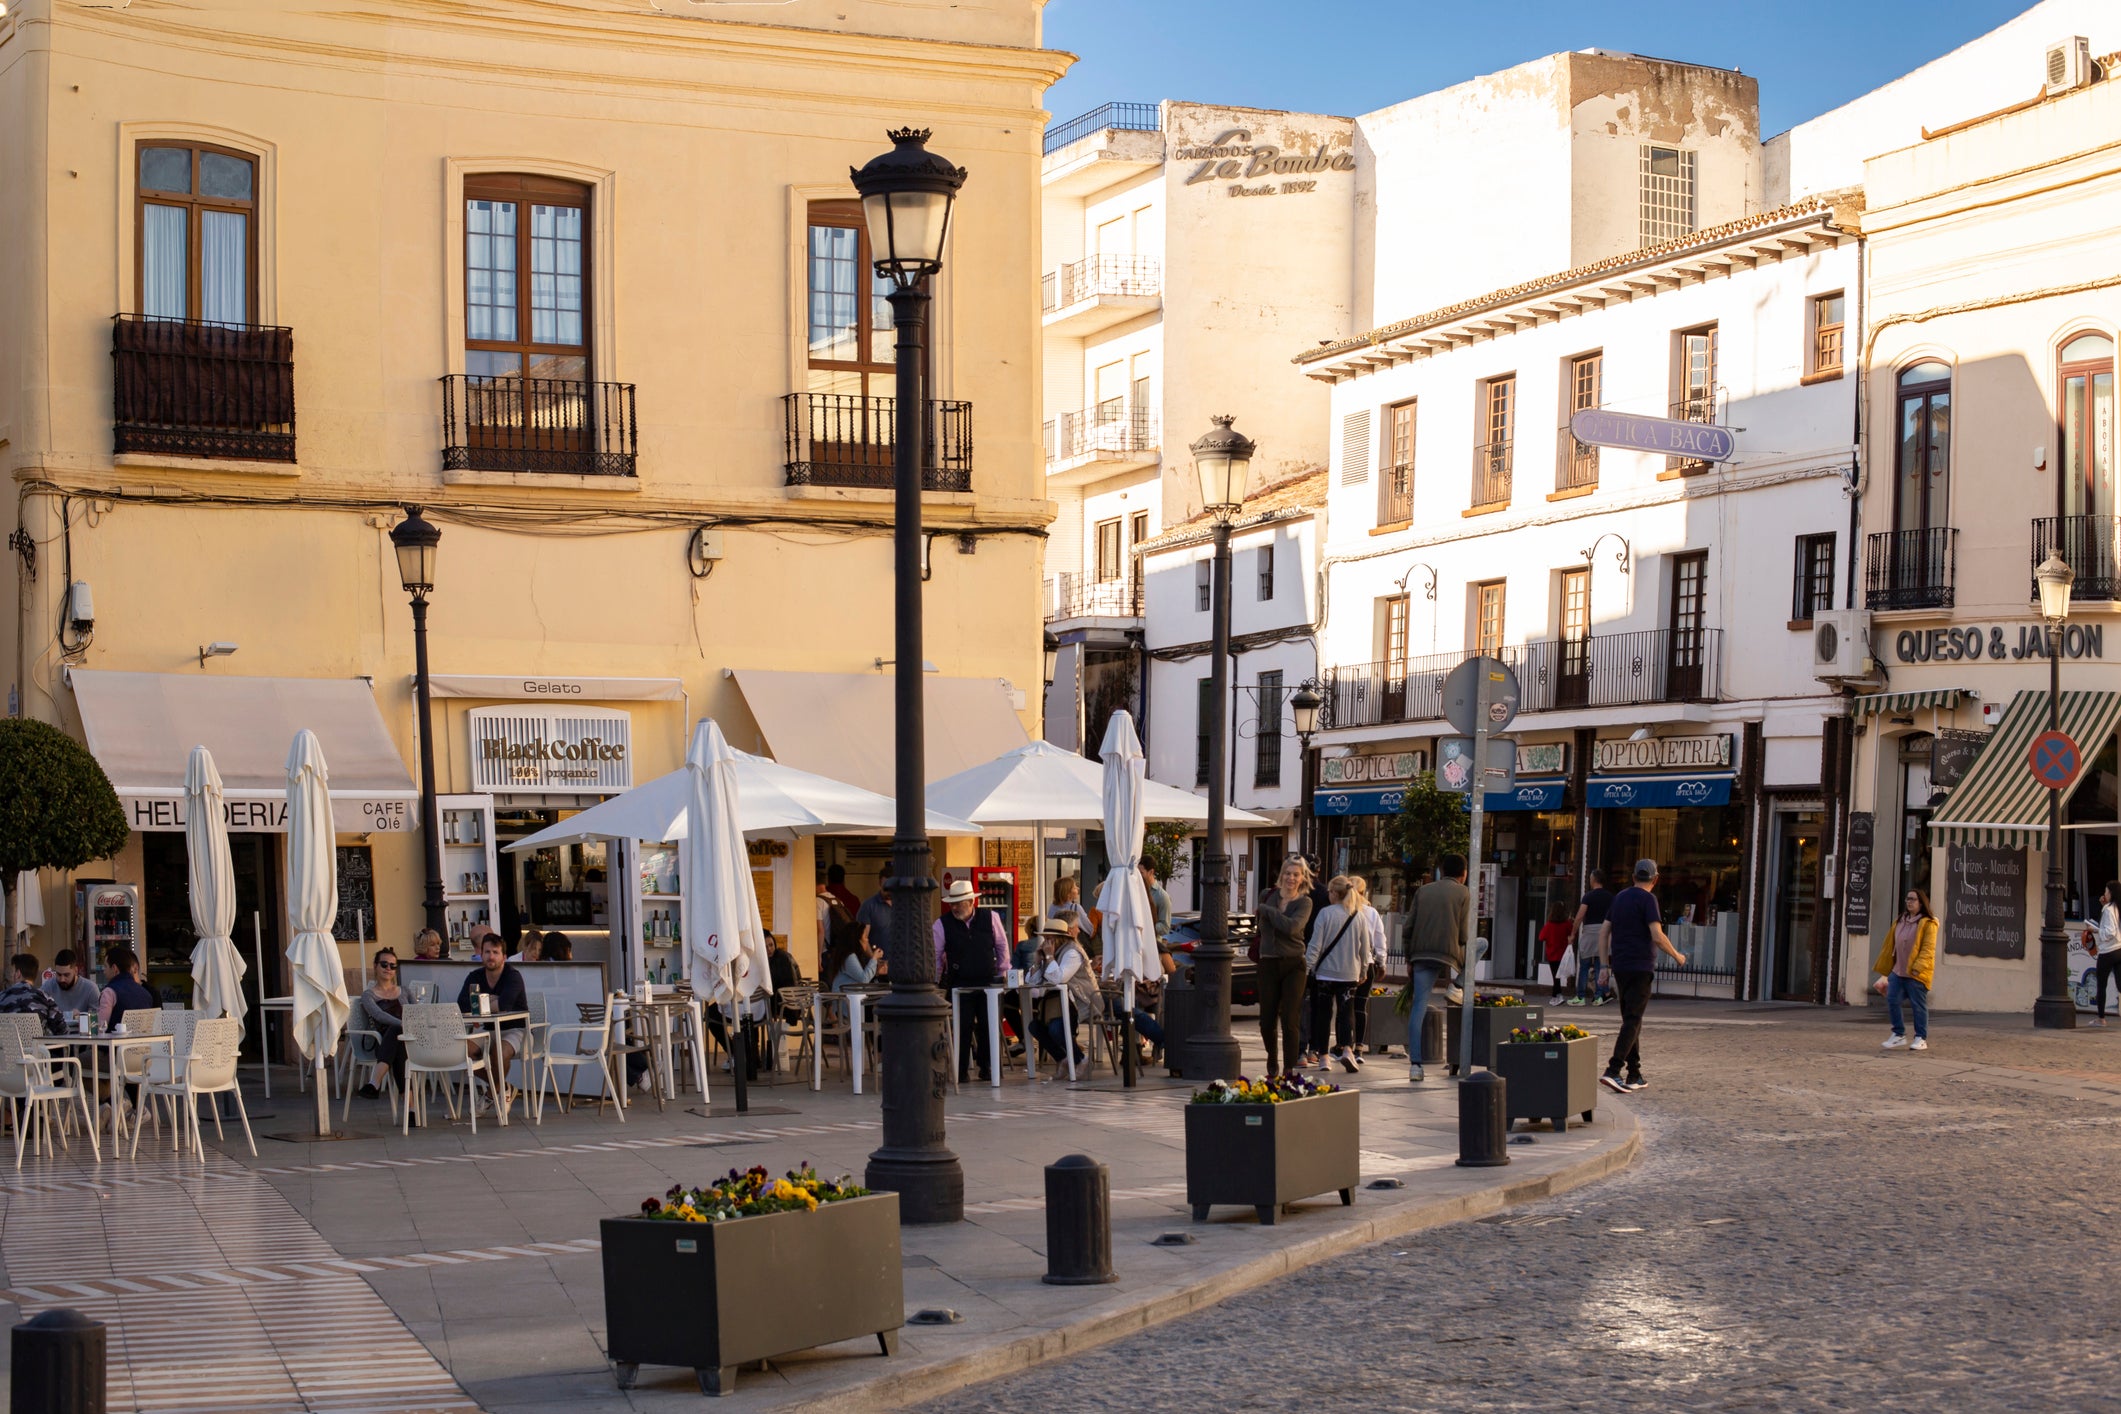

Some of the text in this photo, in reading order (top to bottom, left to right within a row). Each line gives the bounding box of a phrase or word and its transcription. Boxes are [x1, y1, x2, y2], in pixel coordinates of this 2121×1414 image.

[1175, 145, 1254, 160] CALZADOS
[1185, 129, 1356, 186] La Bomba
[1670, 426, 1723, 454] BACA
[1896, 626, 1984, 663] QUESO
[1988, 627, 2006, 659] &
[523, 681, 582, 694] Gelato
[1601, 739, 1724, 767] OPTOMETRIA
[509, 767, 598, 780] 100% organic
[1344, 756, 1397, 780] OPTICA
[135, 800, 405, 827] HELERIA CAFE
[376, 816, 401, 830] Olé
[1991, 881, 2012, 897] Ronda
[1955, 899, 2015, 918] Quesos Artesanos
[1951, 923, 2020, 949] Productos de Jabugo
